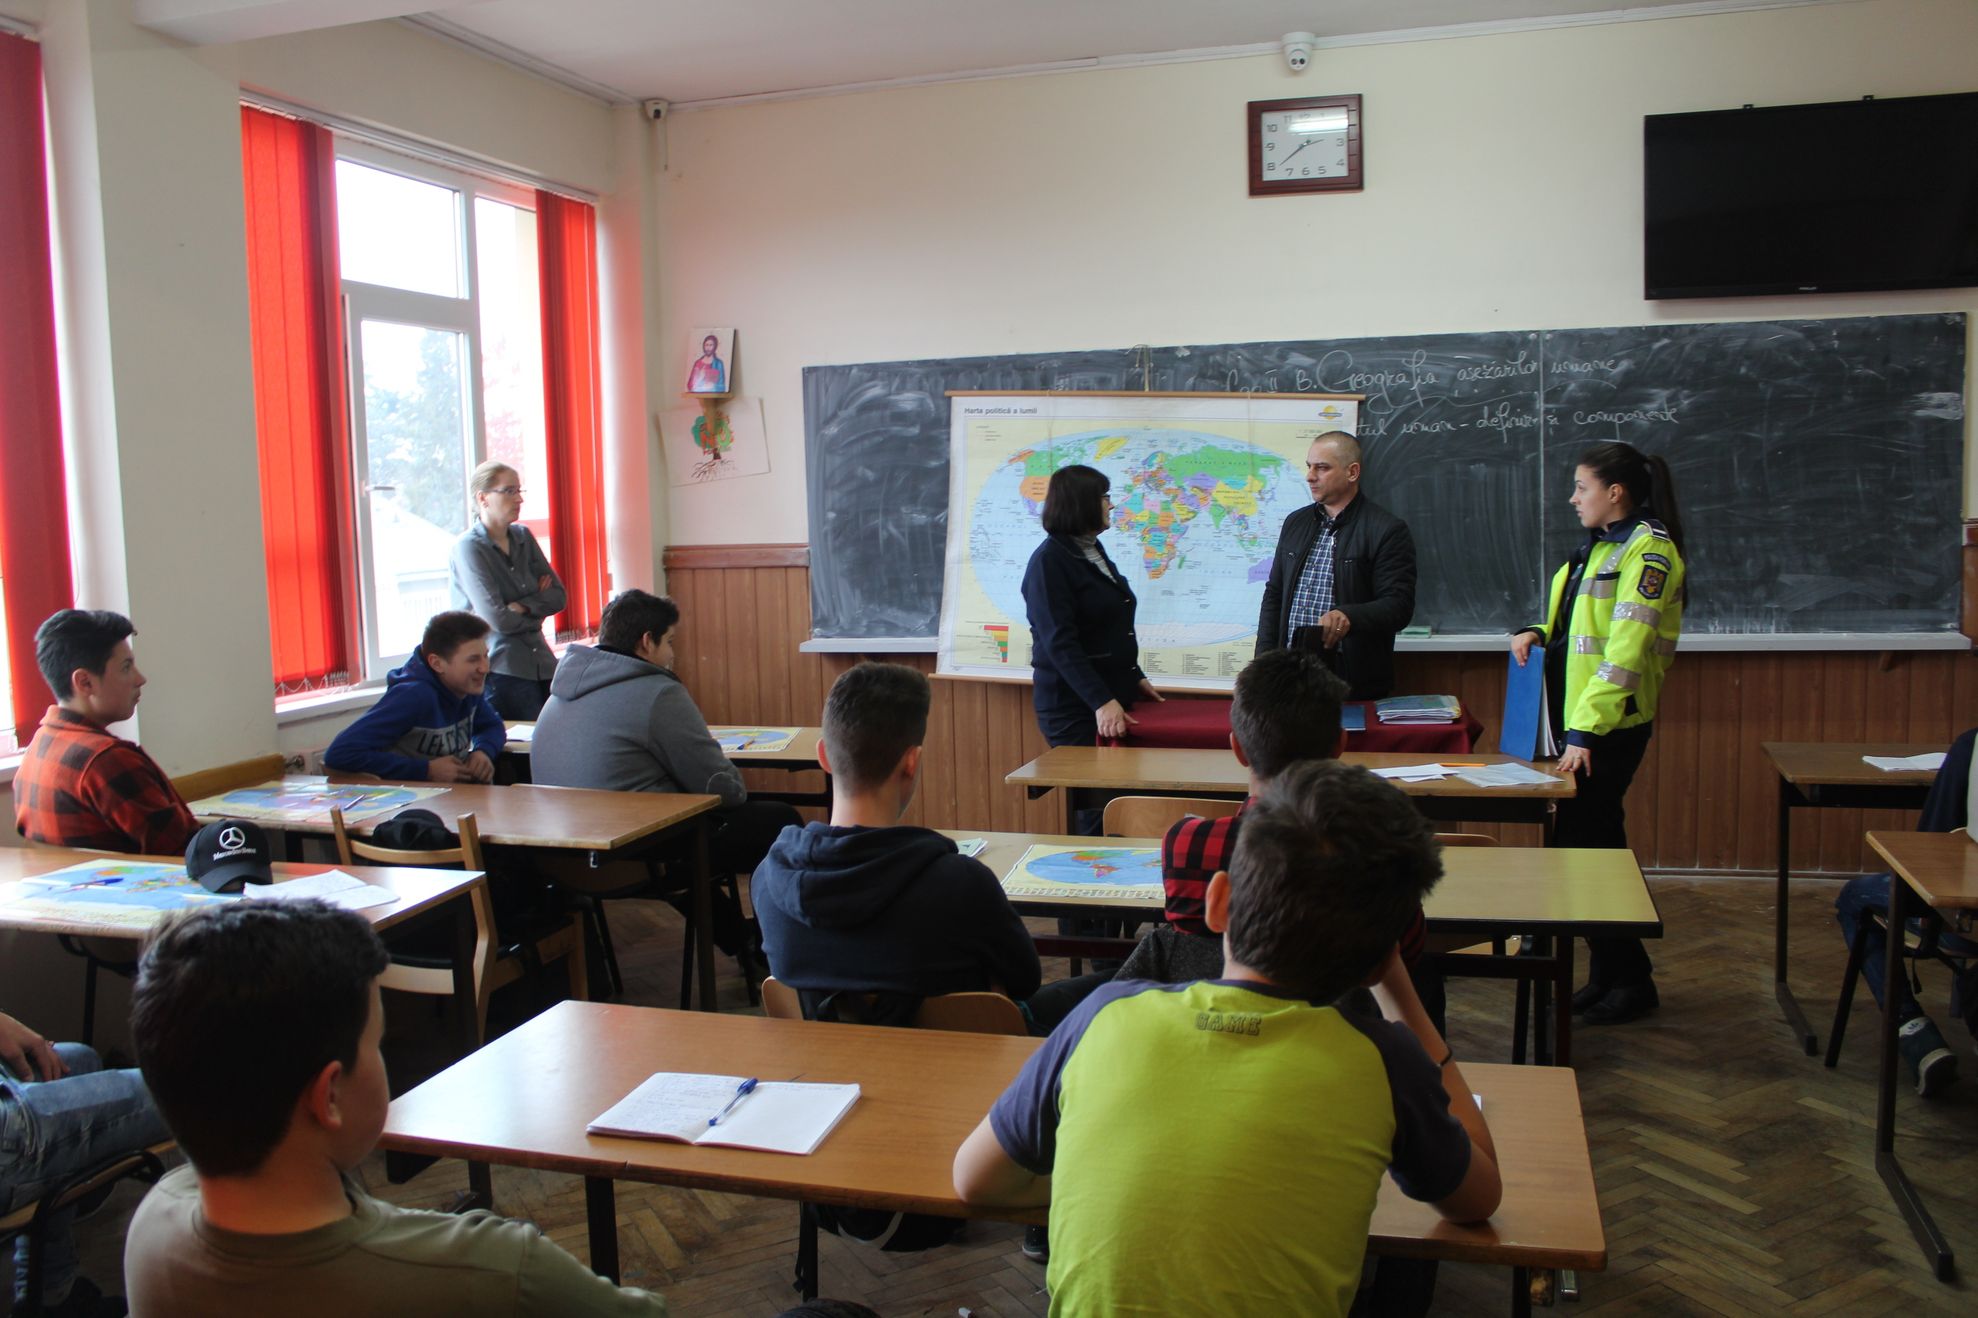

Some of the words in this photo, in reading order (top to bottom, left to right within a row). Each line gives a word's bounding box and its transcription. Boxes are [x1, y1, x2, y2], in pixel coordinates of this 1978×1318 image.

[1266, 124, 1278, 132] 10
[1265, 142, 1275, 151] 9
[1336, 138, 1345, 147] 3
[1266, 162, 1276, 171] 8
[1336, 159, 1345, 167] 4
[1286, 168, 1294, 176] 7
[1302, 167, 1310, 176] 6
[1318, 166, 1327, 174] 5
